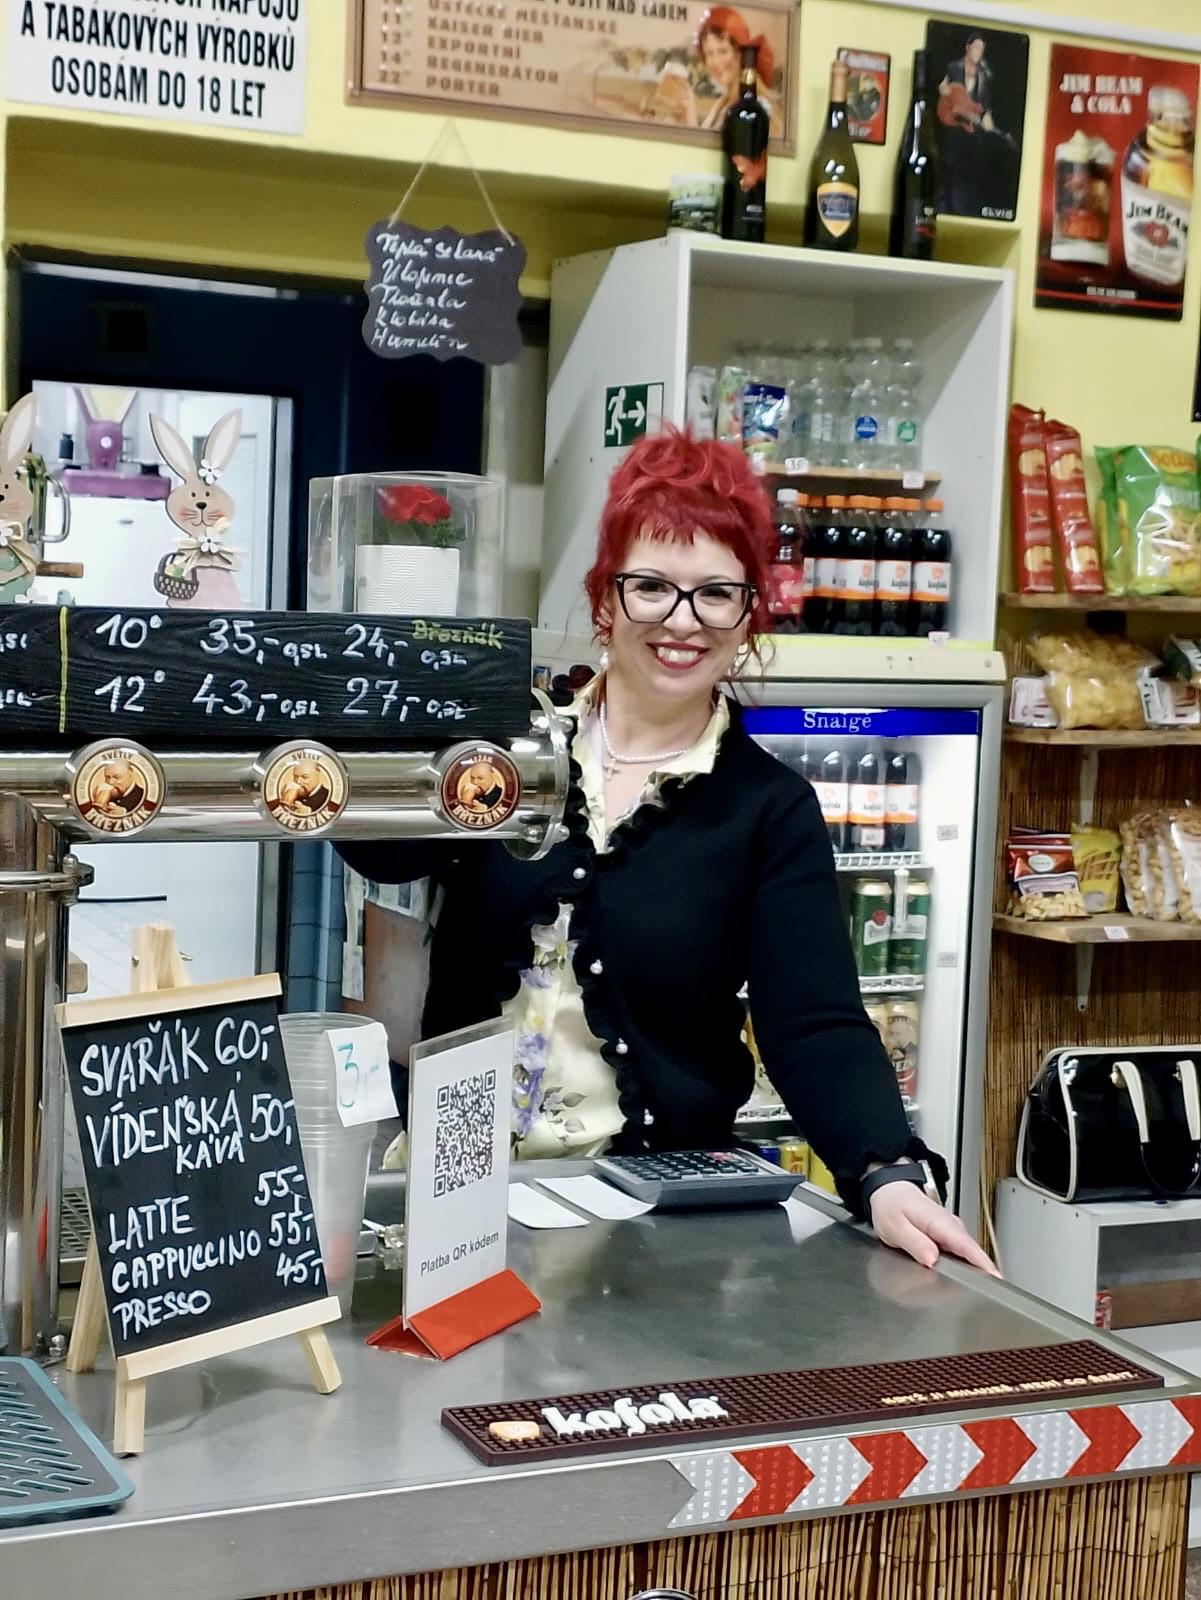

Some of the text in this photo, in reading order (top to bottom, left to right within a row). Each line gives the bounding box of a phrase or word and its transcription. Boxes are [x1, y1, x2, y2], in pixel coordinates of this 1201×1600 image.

[428, 17, 493, 36] KAISER
[503, 27, 544, 43] BIER
[642, 4, 688, 21] LABEM
[21, 0, 296, 72] A TABÁKOVÝCH VÝROBKŮ
[428, 36, 521, 59] EXPORTNÍ
[52, 55, 267, 118] OSOBÁM DO 18 LET
[426, 75, 500, 96] PORTER
[427, 55, 559, 84] REGENERÁTOR
[1059, 73, 1143, 96] JIM BEAM
[1071, 94, 1132, 115] & COLA
[981, 206, 1013, 219] ELVIS
[96, 614, 162, 648] 10°
[200, 618, 279, 665] 35,-
[342, 624, 408, 667] 24,-
[95, 670, 166, 713] 12°
[192, 673, 278, 722] 43,-
[342, 677, 421, 722] 27,-
[79, 1016, 275, 1099] SVAŘÁK 60,-
[176, 1134, 246, 1175] KÁVA
[107, 1195, 197, 1255] LATTE
[111, 1229, 262, 1294] CAPPUCCINO
[420, 1231, 499, 1277] Platba QR kódem
[112, 1289, 212, 1340] PRESSO
[541, 1392, 729, 1438] kofola
